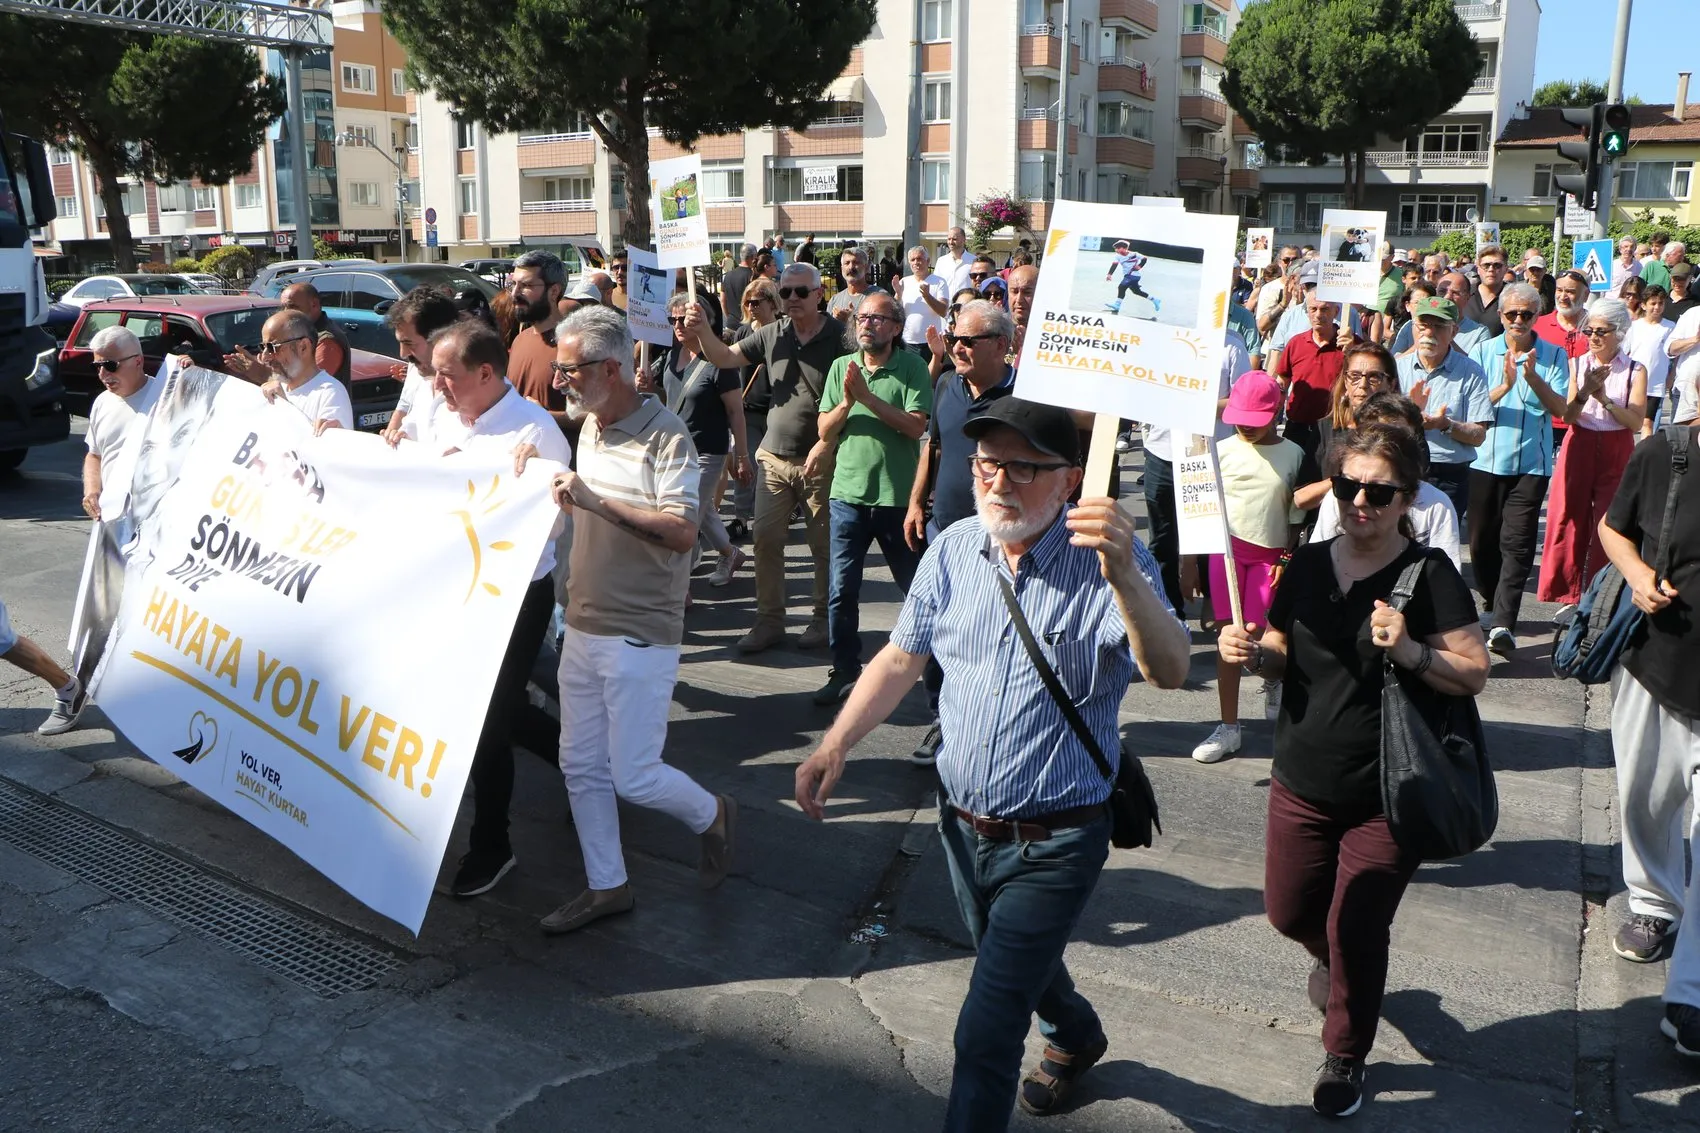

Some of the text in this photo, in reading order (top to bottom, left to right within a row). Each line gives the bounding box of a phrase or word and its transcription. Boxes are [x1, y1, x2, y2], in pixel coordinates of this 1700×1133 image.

[277, 234, 285, 246] D
[1045, 311, 1105, 328] BAŞKA
[1040, 332, 1128, 353] SÖNMESİN
[1042, 322, 1141, 346] GÜNEŞ'LER
[1039, 342, 1072, 354] DİYE
[1036, 351, 1208, 391] HAYATA YOL VER!
[1180, 460, 1207, 472] BAŞKA
[1183, 494, 1199, 503] DİYE
[1184, 502, 1218, 514] HAYATA
[190, 514, 322, 604] SÖNMESİN
[166, 553, 222, 592] DİYE
[143, 585, 447, 798] HAYATA YOL VER!
[240, 750, 282, 790] YOL VER,
[236, 770, 309, 828] HAYAT KURTAR.
